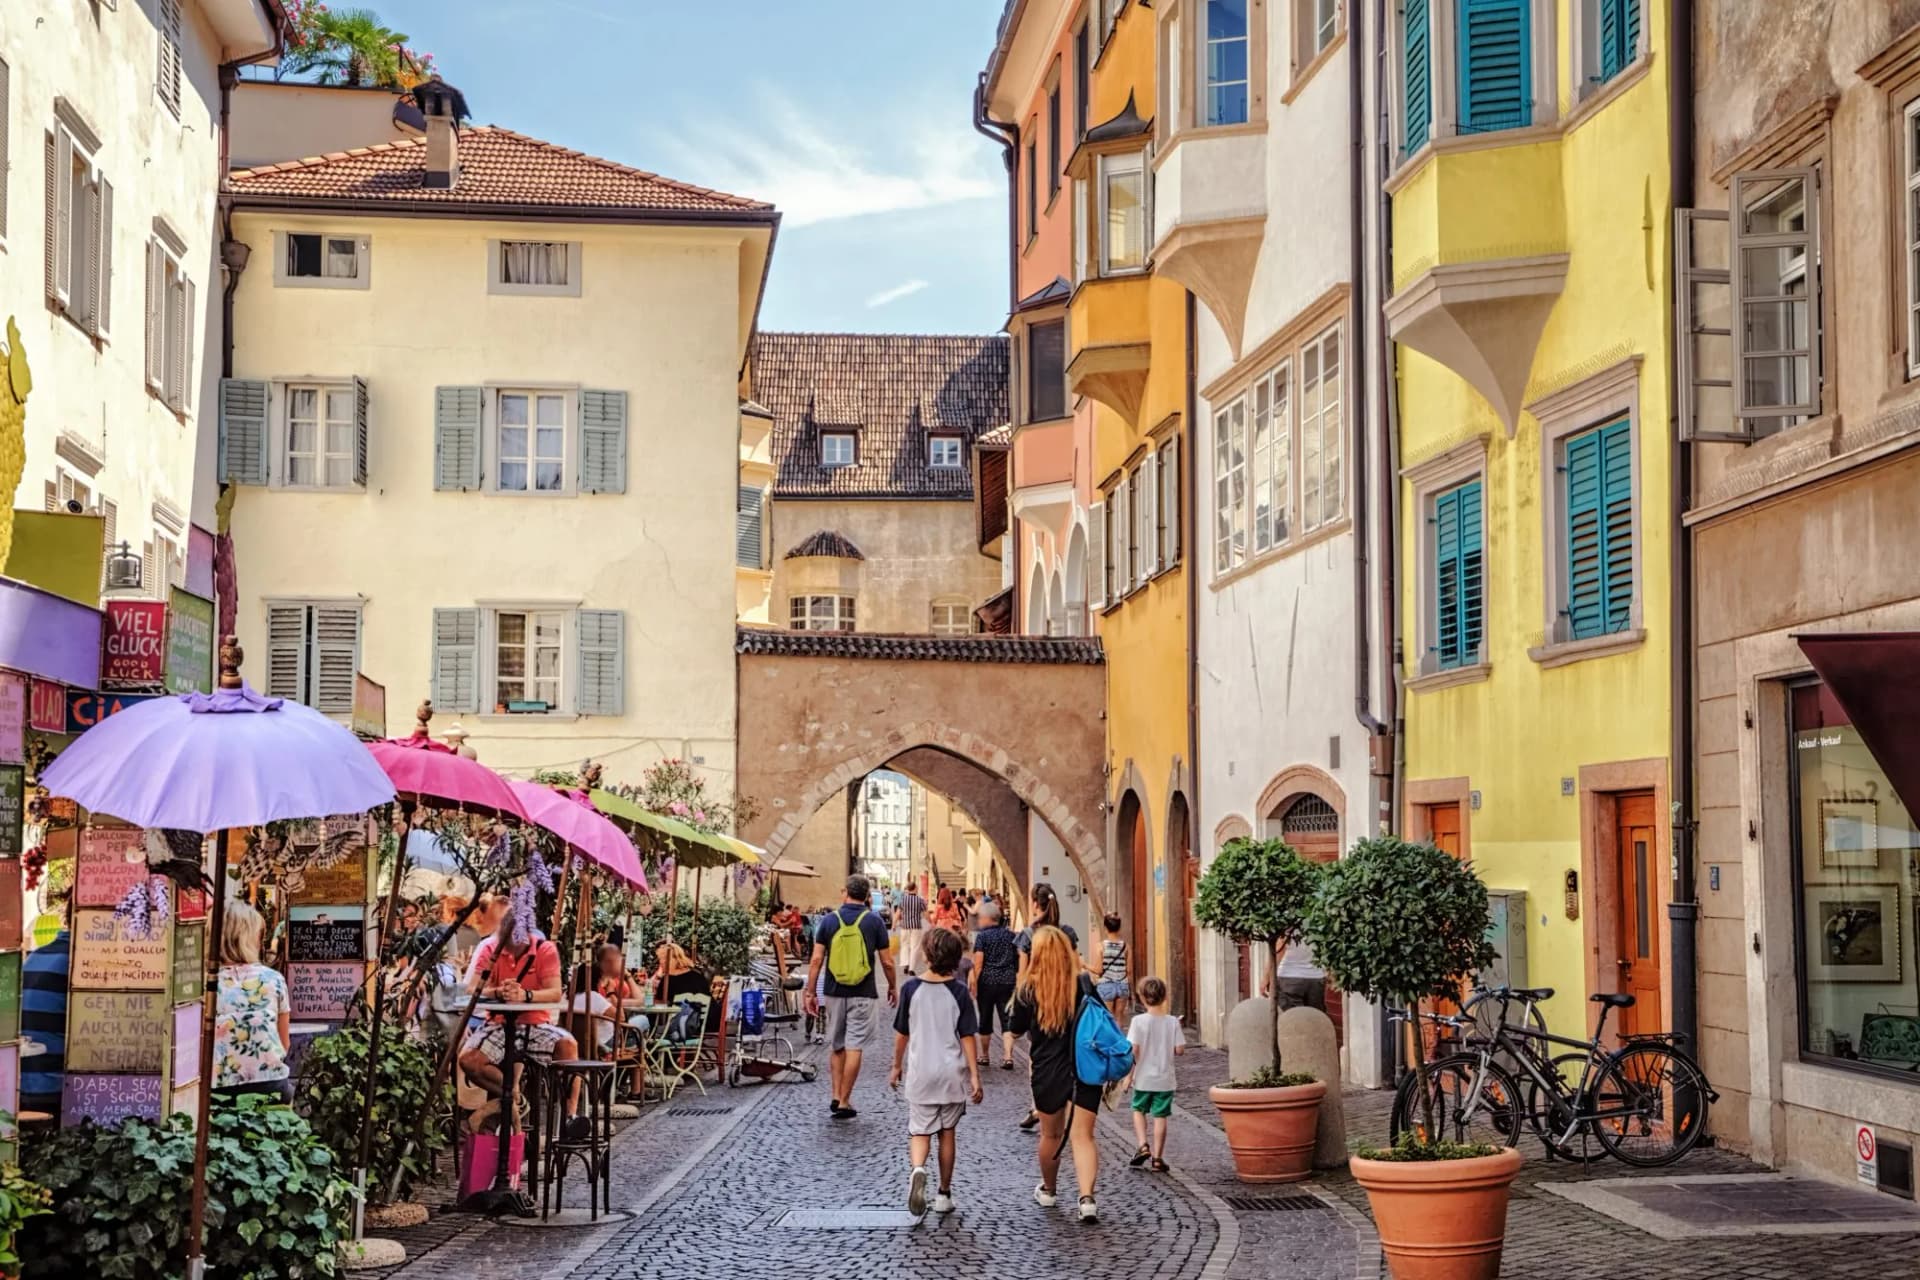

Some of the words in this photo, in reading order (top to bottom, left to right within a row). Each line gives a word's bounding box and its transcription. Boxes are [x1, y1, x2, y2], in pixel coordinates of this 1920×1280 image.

[107, 632, 160, 656] GLÜCK
[113, 659, 149, 669] GOOD
[110, 668, 154, 679] LUCK
[1798, 738, 1817, 750] Ankauf
[1820, 734, 1841, 747] Verkauf
[292, 985, 316, 993] ABER
[319, 985, 354, 993] MANCHE
[83, 996, 116, 1009] GEH
[79, 1021, 122, 1036] AUCH
[73, 1077, 123, 1092] DABEI
